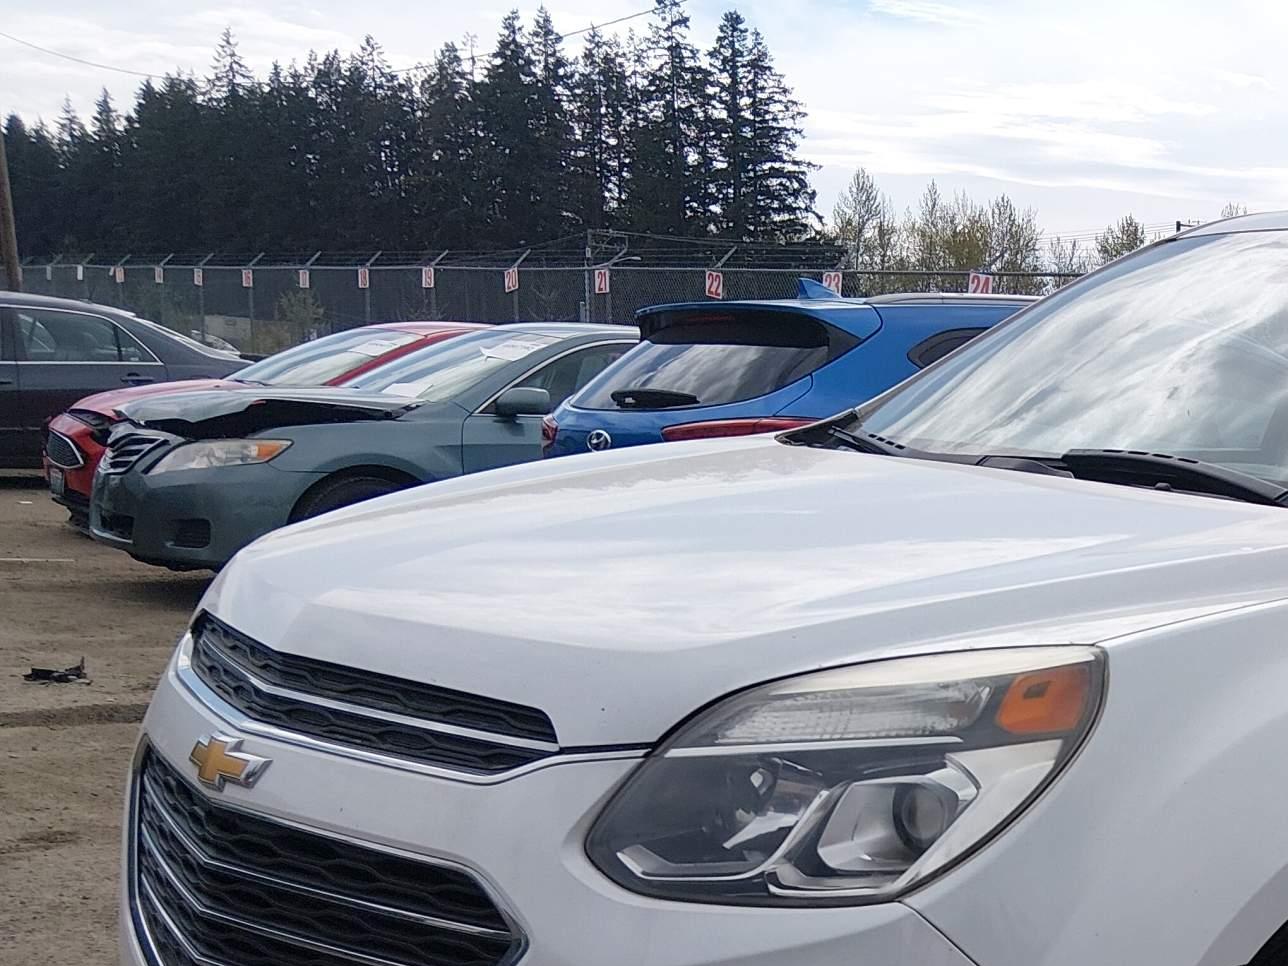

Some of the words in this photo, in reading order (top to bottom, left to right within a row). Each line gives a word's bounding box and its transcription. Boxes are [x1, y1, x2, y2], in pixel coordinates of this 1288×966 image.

[423, 268, 433, 287] 19
[505, 269, 517, 290] 20
[597, 271, 607, 292] 21
[707, 272, 721, 298] 22
[825, 273, 840, 294] 23
[971, 274, 991, 294] 24
